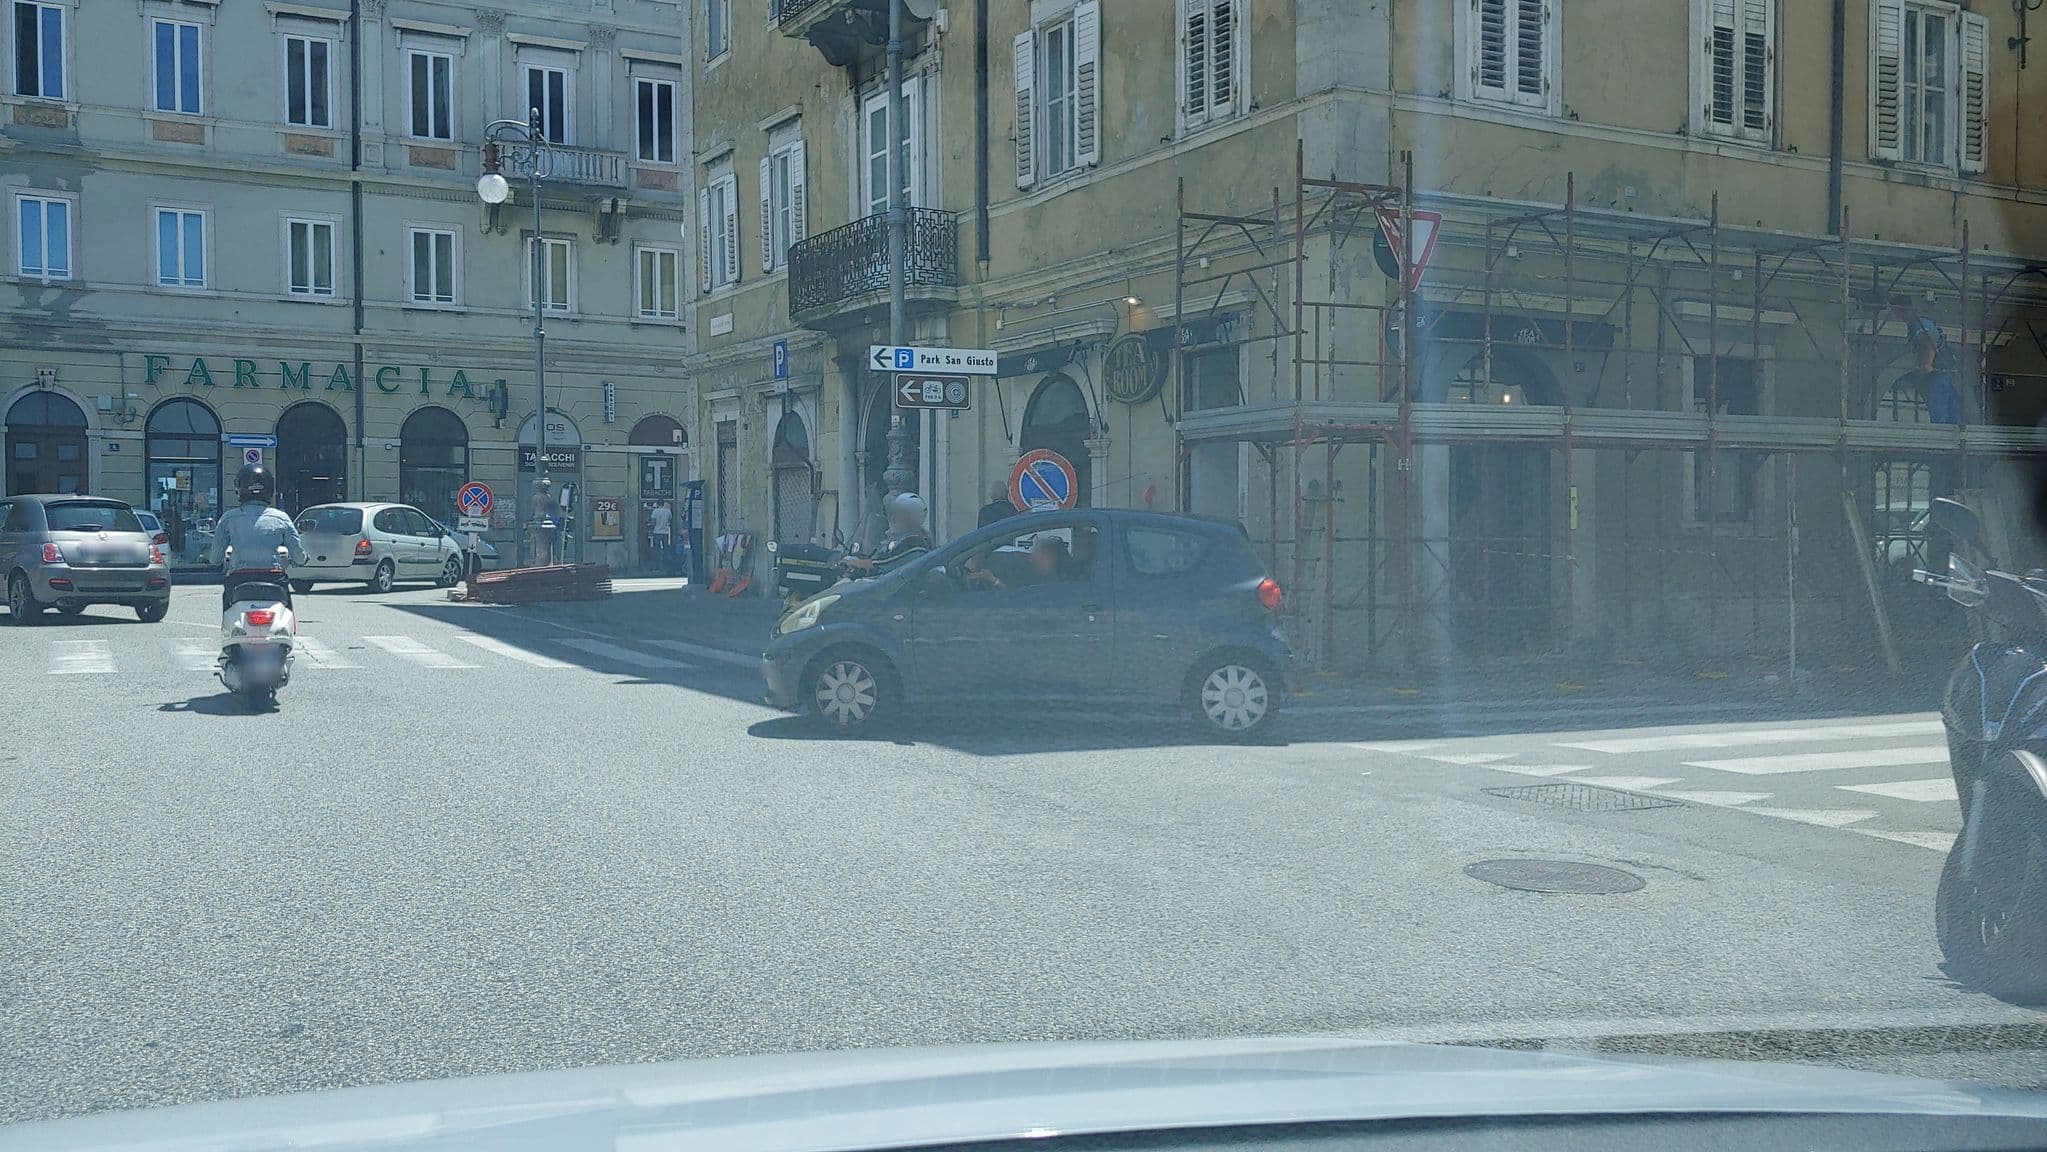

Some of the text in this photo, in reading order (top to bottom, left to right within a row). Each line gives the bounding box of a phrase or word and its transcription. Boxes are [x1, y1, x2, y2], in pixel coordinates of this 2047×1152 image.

[776, 345, 784, 376] P
[921, 354, 940, 364] Park
[946, 355, 961, 365] San
[967, 356, 994, 367] Giusto
[144, 354, 475, 396] FARMACIA
[533, 423, 565, 431] IOS
[524, 452, 575, 462] TAACCHI
